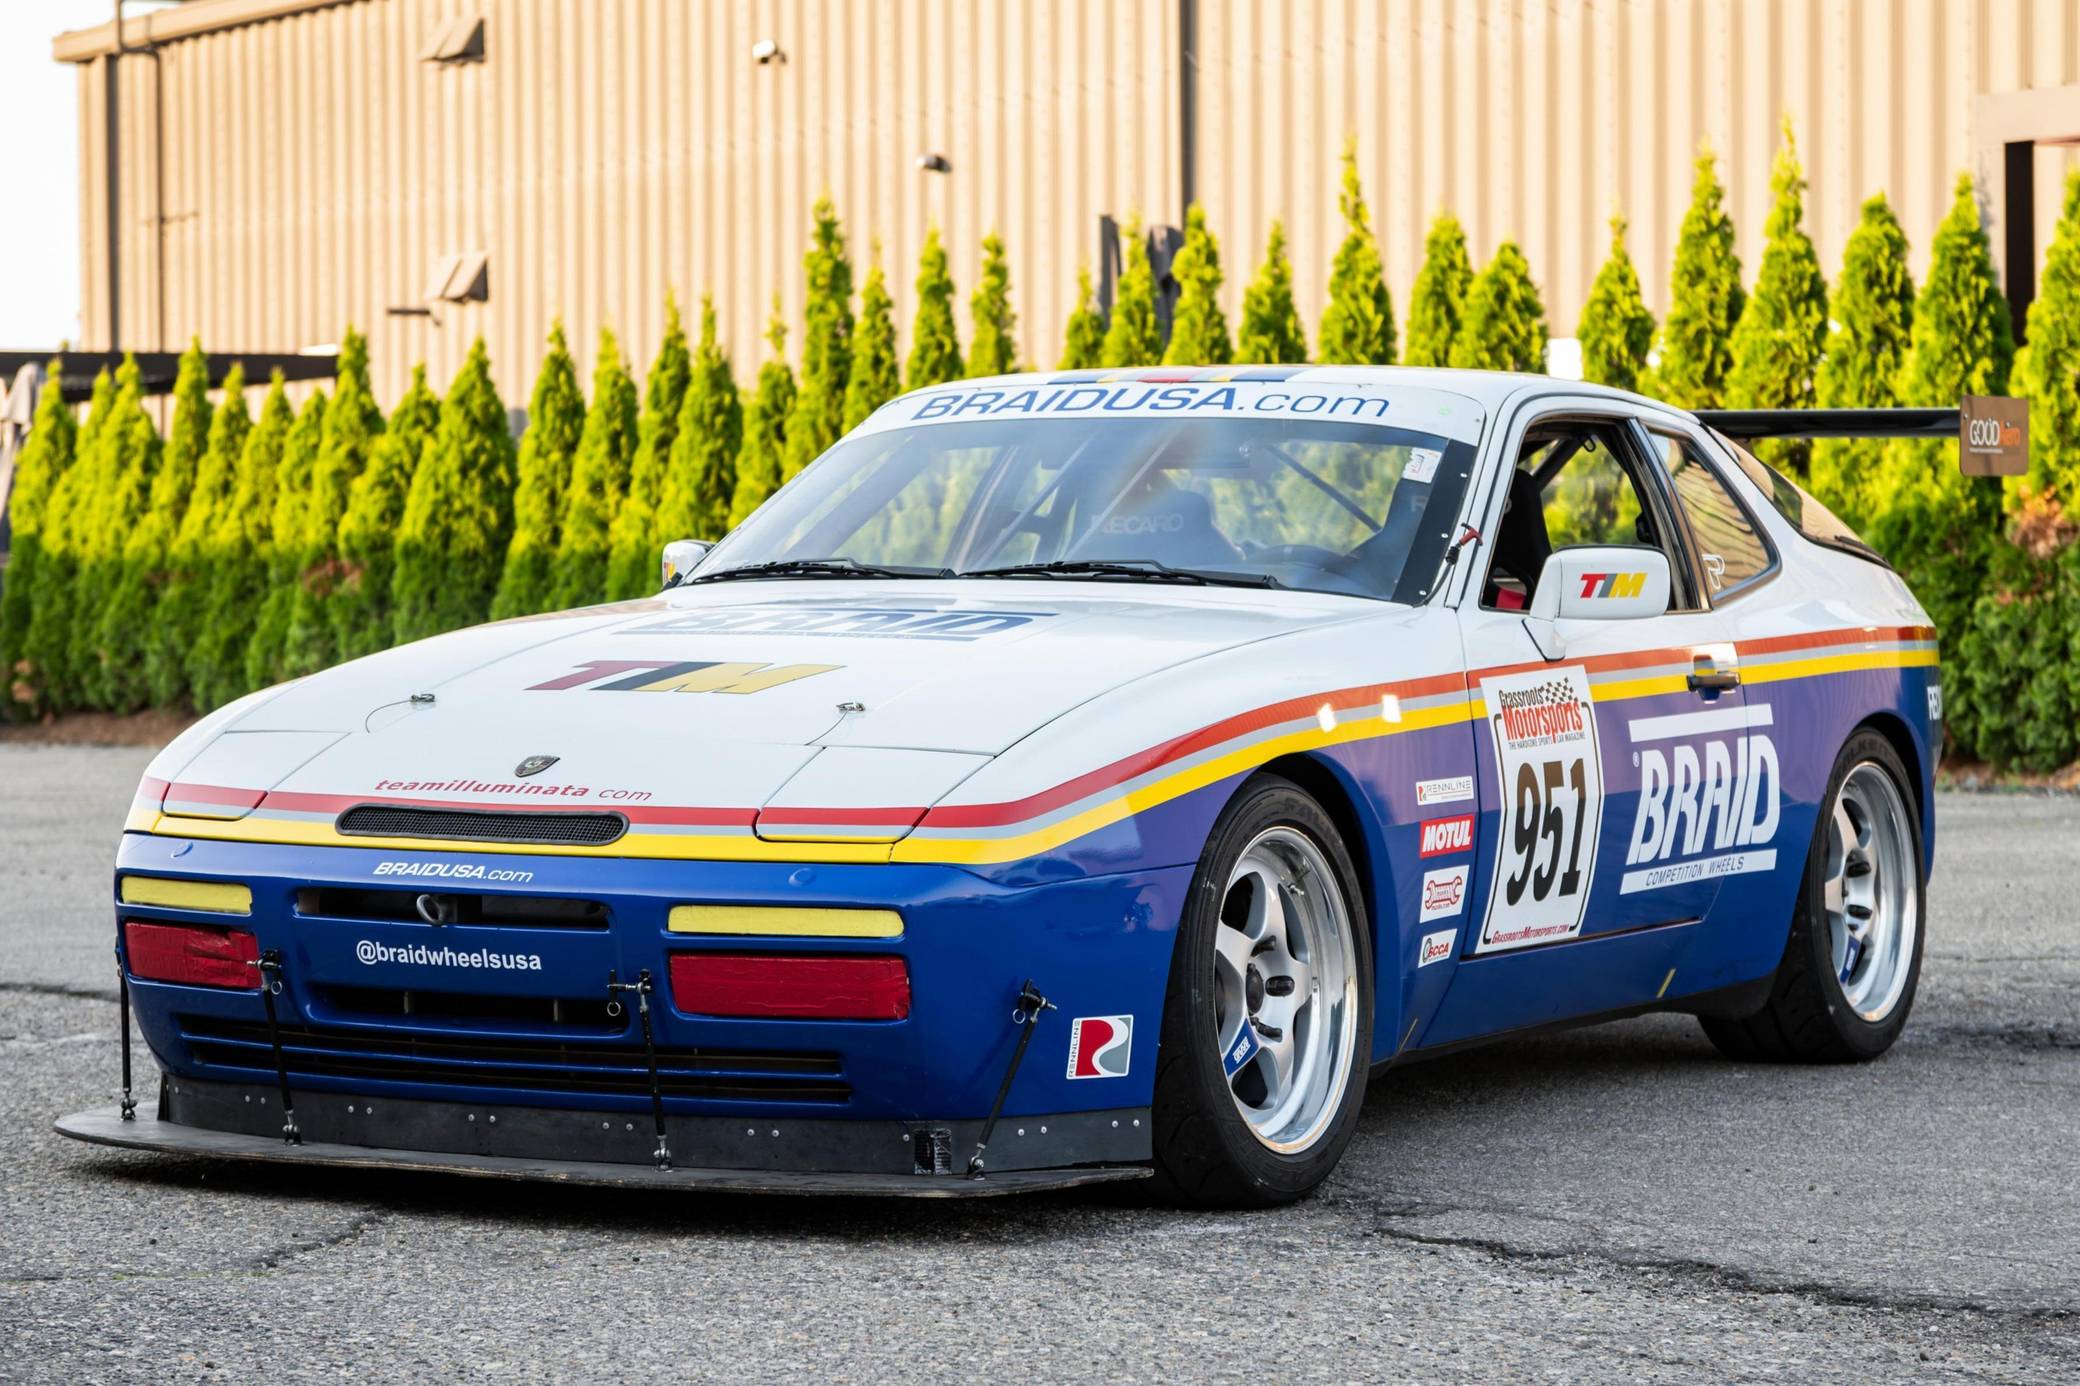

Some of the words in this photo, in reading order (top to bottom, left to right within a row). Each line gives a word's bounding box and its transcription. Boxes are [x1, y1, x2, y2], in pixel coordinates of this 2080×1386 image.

[911, 387, 1390, 421] BRAIDUSA.com
[641, 612, 1034, 635] BRAID
[1499, 688, 1544, 709] Grassroots
[1502, 702, 1583, 744] Motorsports
[374, 778, 590, 798] teamilluminata
[598, 787, 652, 802] com
[1427, 780, 1471, 794] RENNLINE
[1625, 735, 1781, 866] BRAID
[1422, 819, 1472, 853] MOTUL
[1506, 758, 1586, 906] 951
[373, 861, 533, 883] BRAIDUSA.com
[1646, 864, 1704, 887] COMPETITION
[1708, 856, 1744, 875] WHEELS
[356, 939, 542, 970] @braidwheelsusa
[1068, 1020, 1080, 1077] RENNLINE
